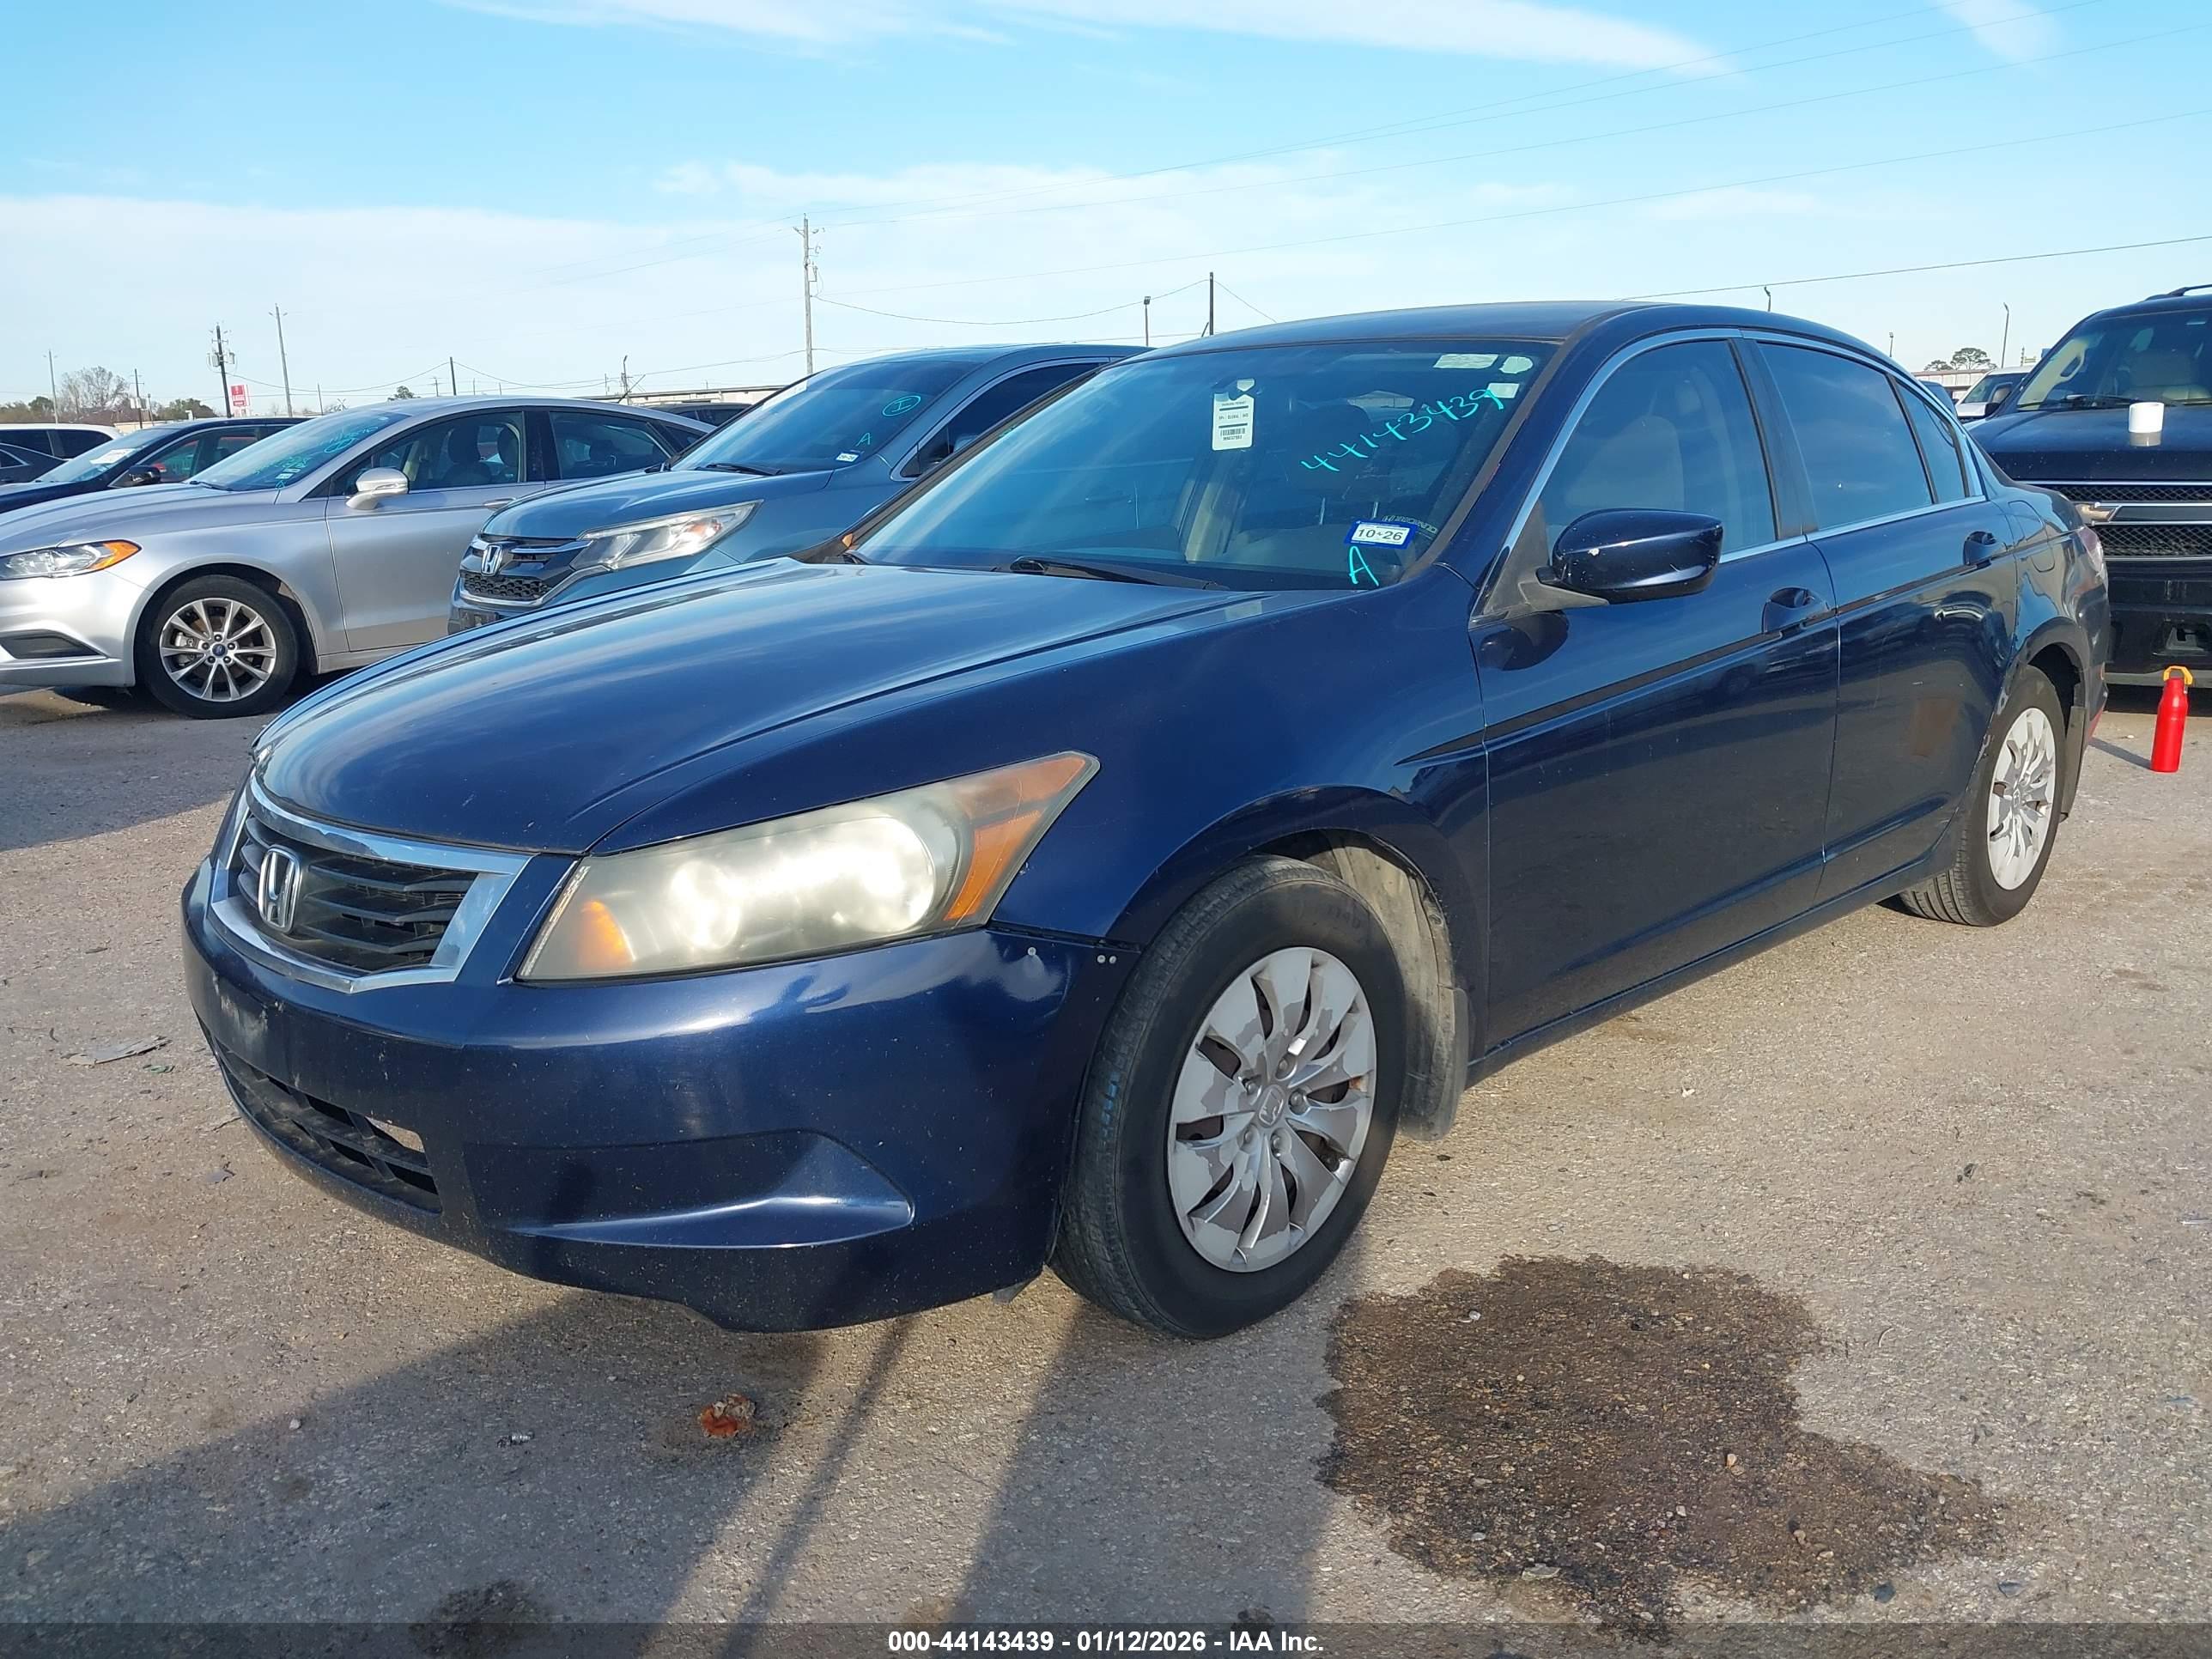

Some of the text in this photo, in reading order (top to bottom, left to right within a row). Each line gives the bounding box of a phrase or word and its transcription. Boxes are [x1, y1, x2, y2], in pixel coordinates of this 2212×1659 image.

[855, 432, 871, 447] A
[1301, 389, 1504, 471] 44143439
[1348, 545, 1380, 586] A
